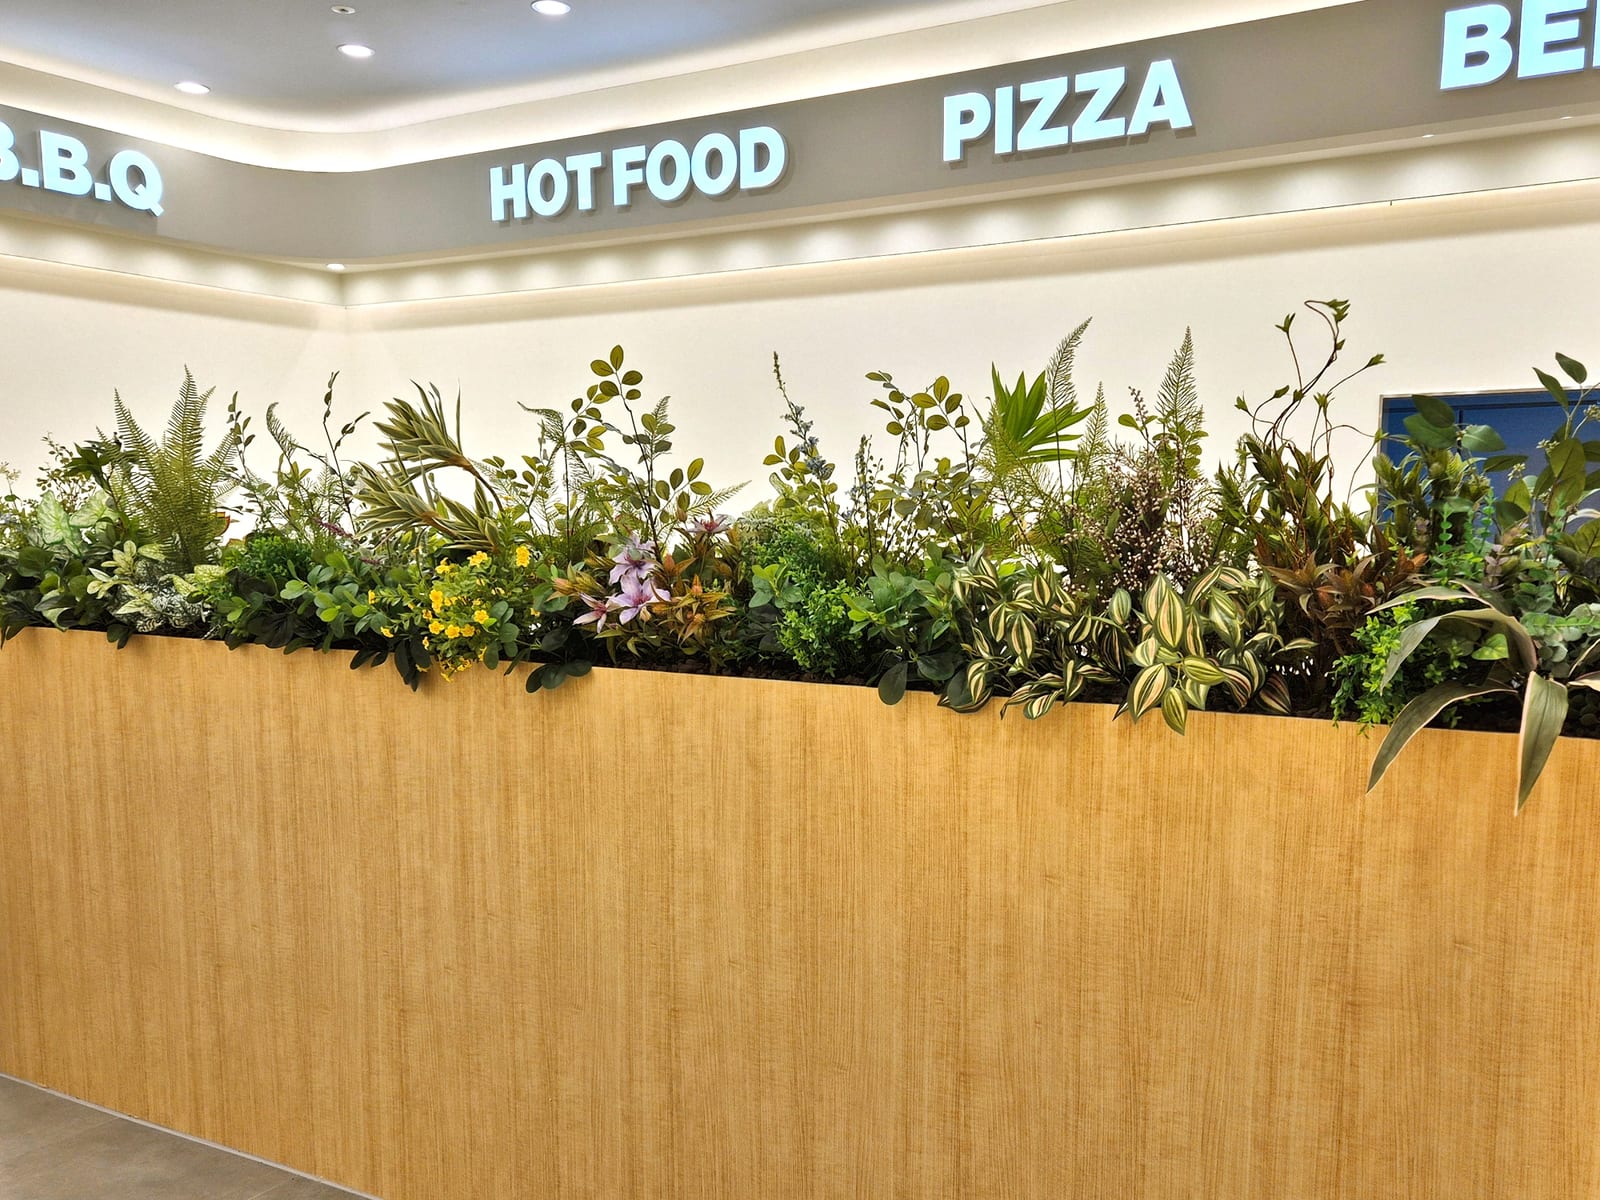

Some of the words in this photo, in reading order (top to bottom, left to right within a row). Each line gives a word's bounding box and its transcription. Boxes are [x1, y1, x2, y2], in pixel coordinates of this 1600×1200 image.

[1440, 0, 1600, 90] BE
[943, 58, 1193, 161] PIZZA
[489, 151, 602, 222] HOT
[612, 126, 786, 206] FOOD
